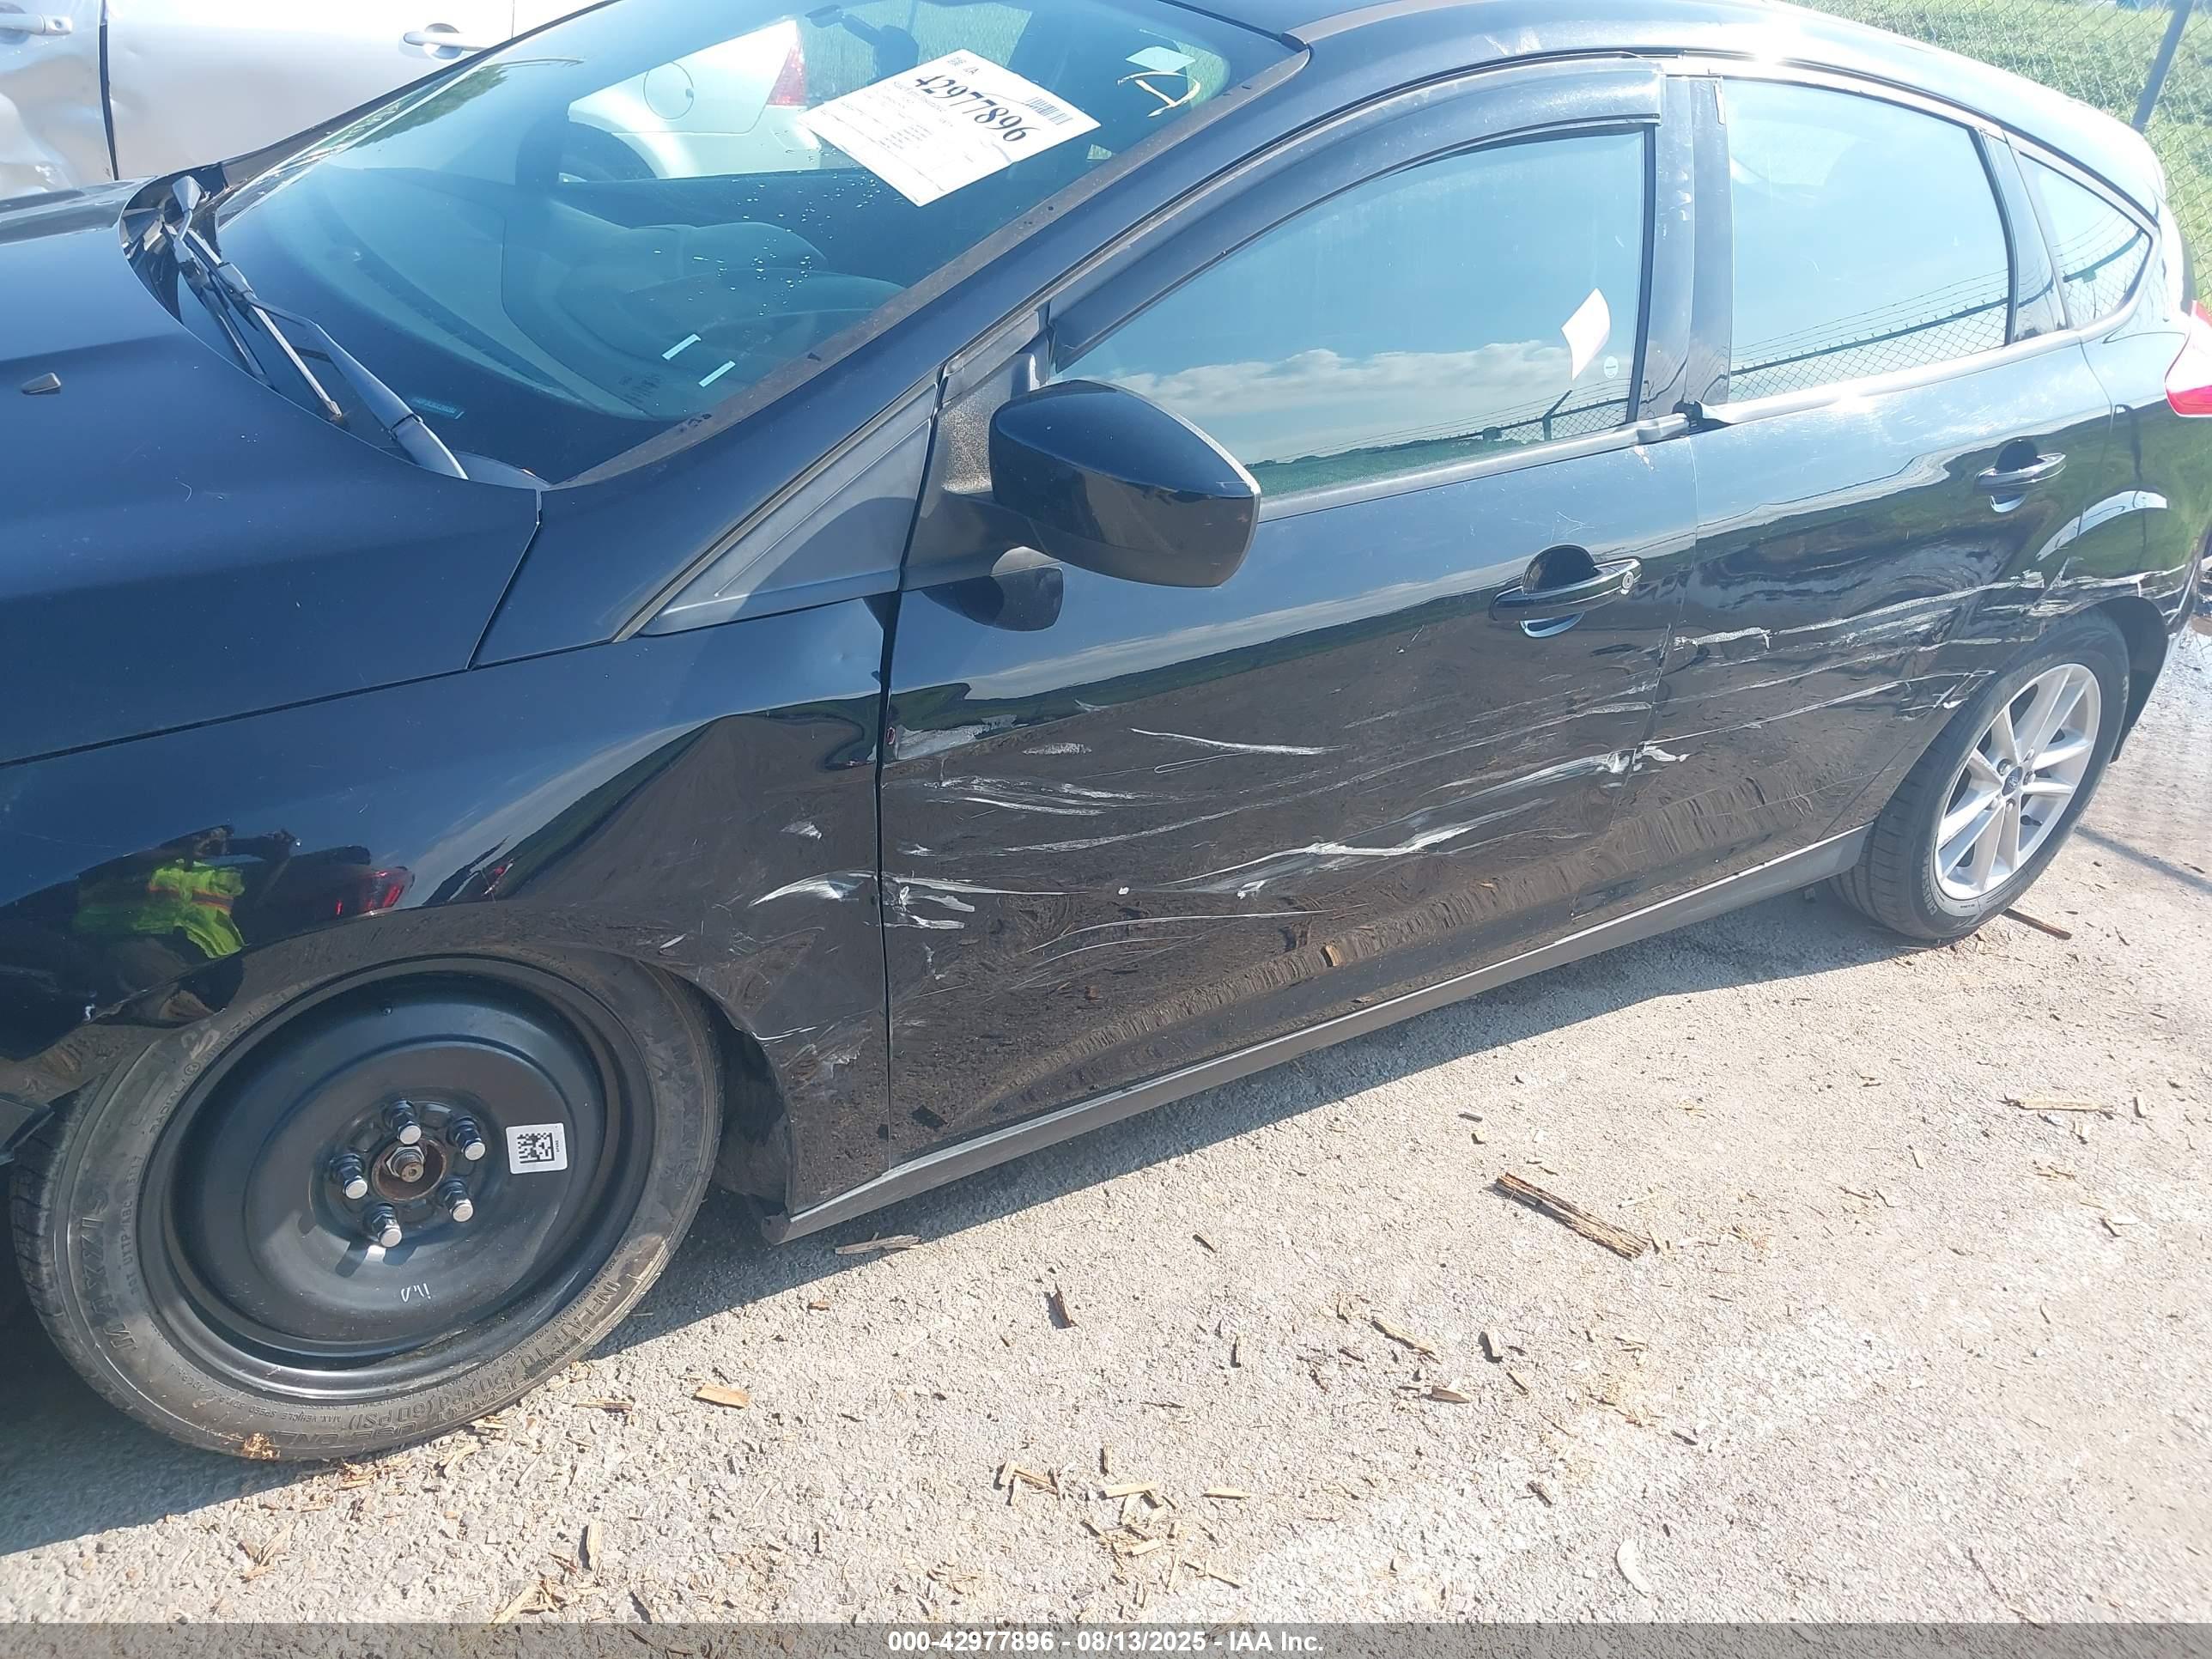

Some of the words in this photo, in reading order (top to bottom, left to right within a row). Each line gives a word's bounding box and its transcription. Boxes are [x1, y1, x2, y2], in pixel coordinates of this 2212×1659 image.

[915, 75, 1041, 142] 42977896
[81, 1188, 137, 1351] MAXXIS
[549, 1279, 623, 1349] INFLATE
[517, 1344, 550, 1371] TO
[248, 1404, 277, 1418] SPEED
[279, 1411, 319, 1423] VEHICLE
[347, 1409, 392, 1431] PSI)
[348, 1419, 416, 1443] USE
